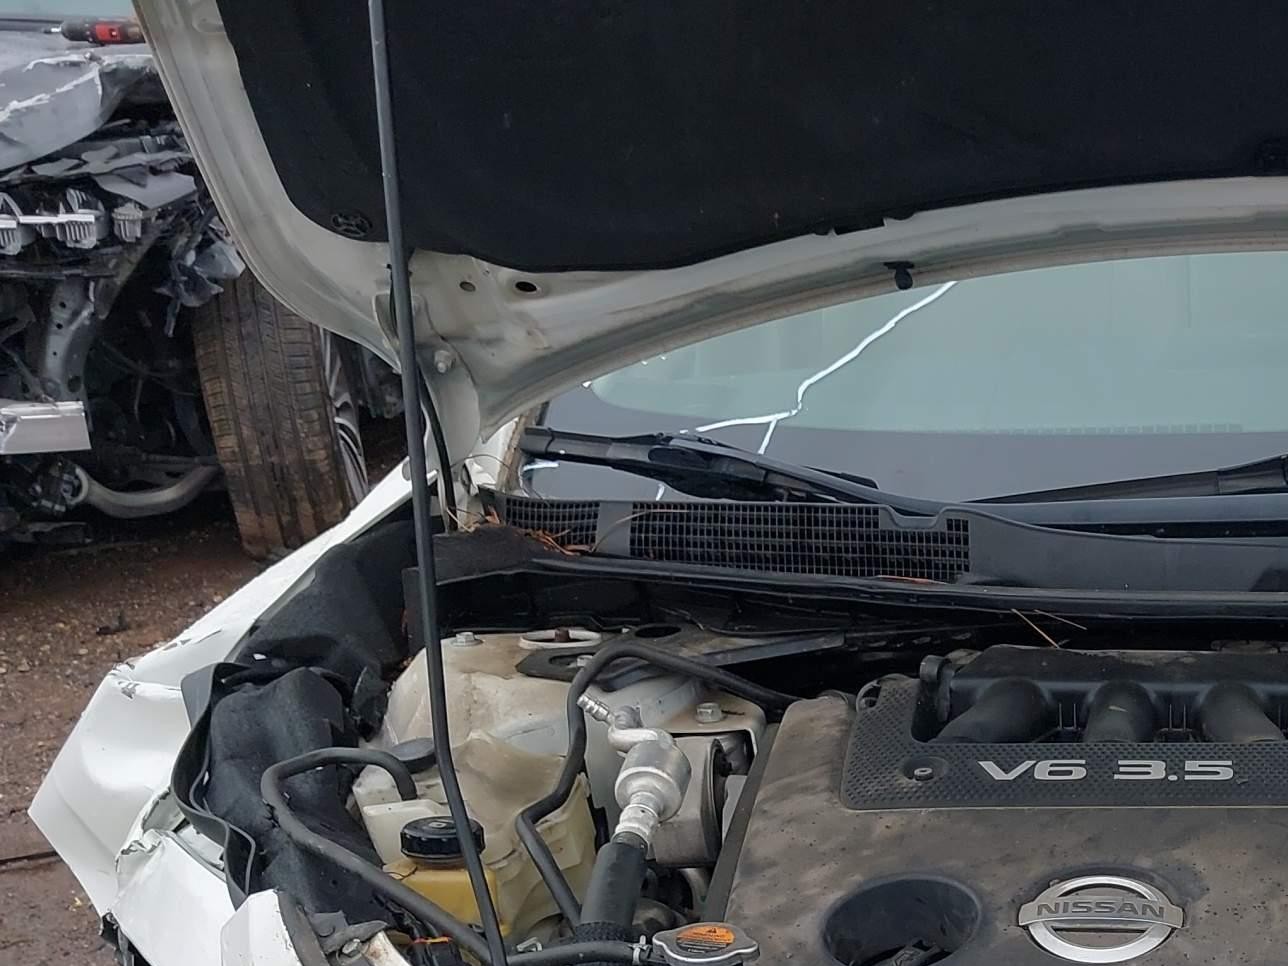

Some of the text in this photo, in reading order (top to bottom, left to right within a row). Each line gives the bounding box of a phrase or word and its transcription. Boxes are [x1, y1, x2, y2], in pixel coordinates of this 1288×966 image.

[978, 758, 1234, 782] V6 3.5
[1035, 901, 1166, 920] NISSAN
